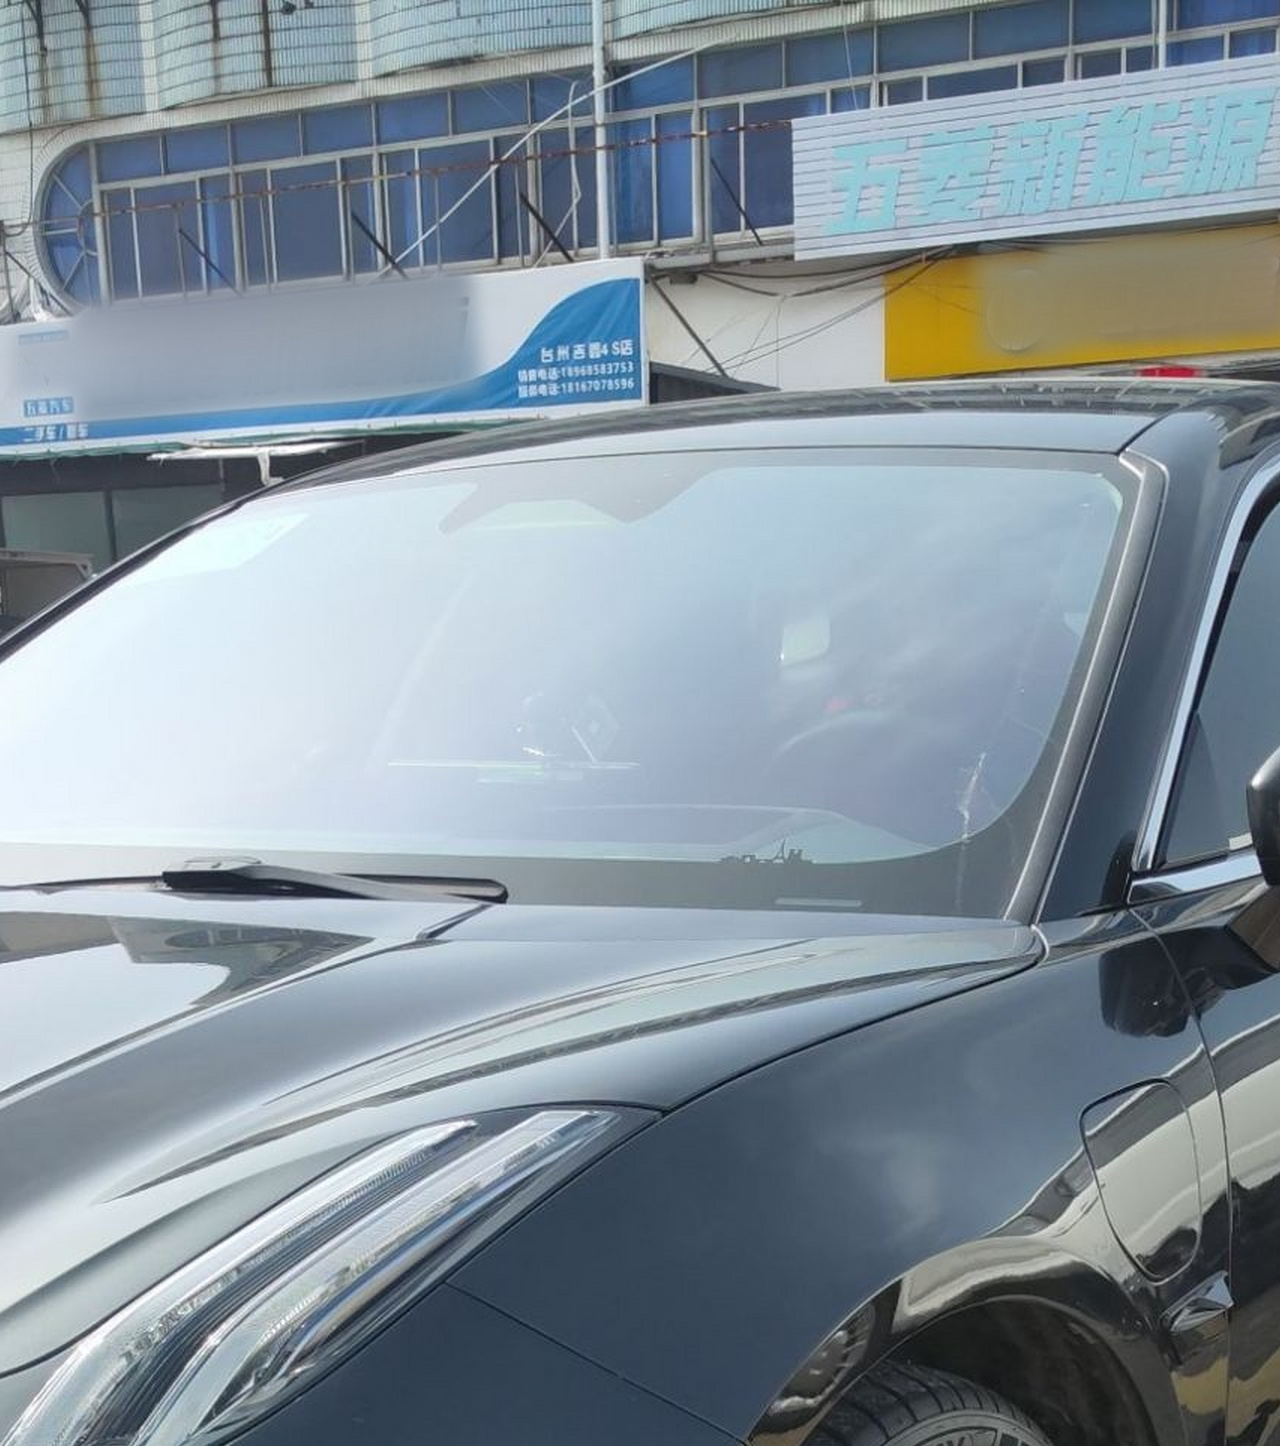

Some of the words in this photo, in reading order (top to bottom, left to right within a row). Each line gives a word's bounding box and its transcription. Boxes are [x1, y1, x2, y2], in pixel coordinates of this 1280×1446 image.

[822, 86, 1276, 235] 五菱新能源
